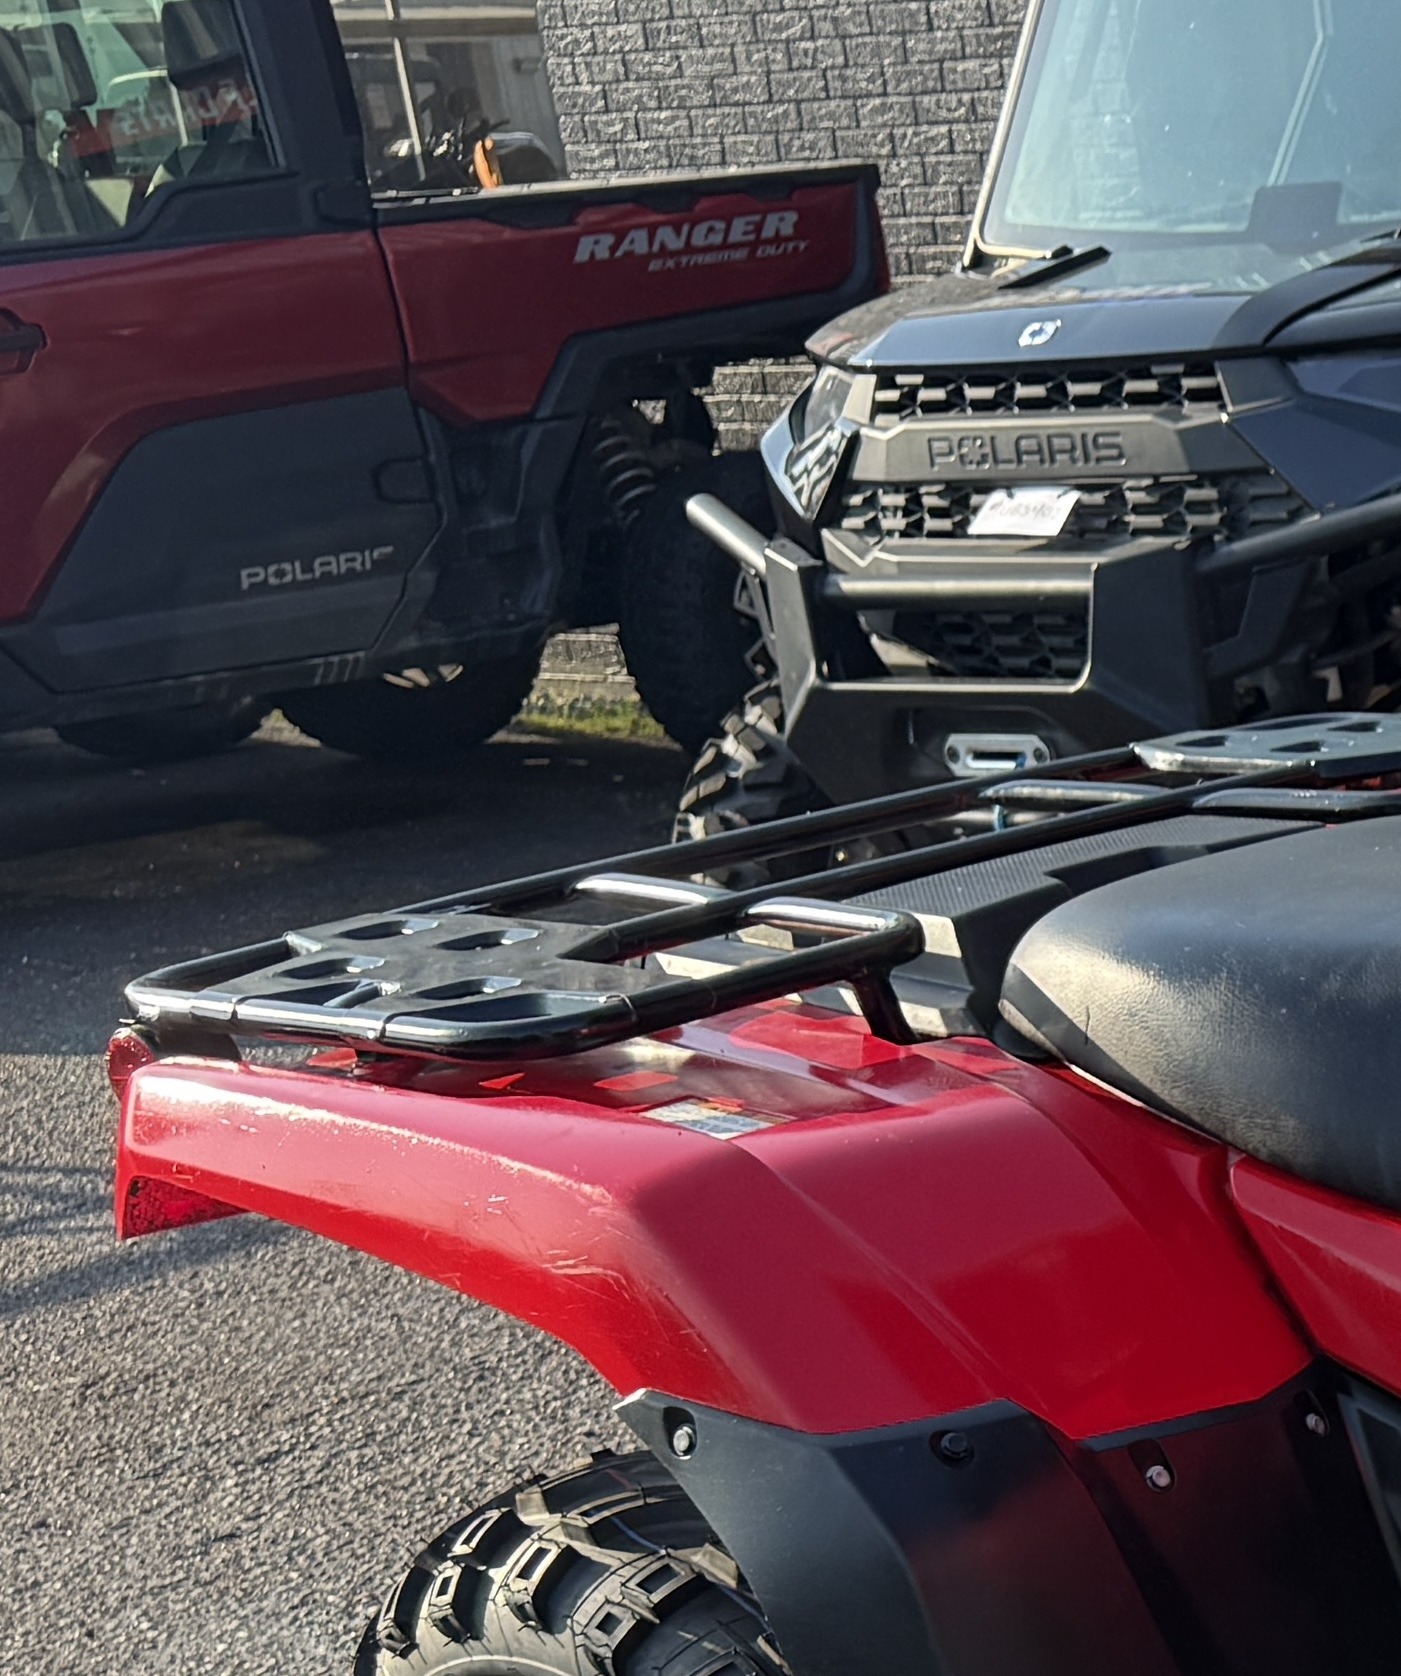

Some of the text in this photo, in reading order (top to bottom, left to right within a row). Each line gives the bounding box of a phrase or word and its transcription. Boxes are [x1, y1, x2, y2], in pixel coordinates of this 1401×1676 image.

[572, 210, 799, 264] RANGER
[648, 239, 810, 272] EXTREME DUTY
[927, 431, 1127, 472] POLARIS
